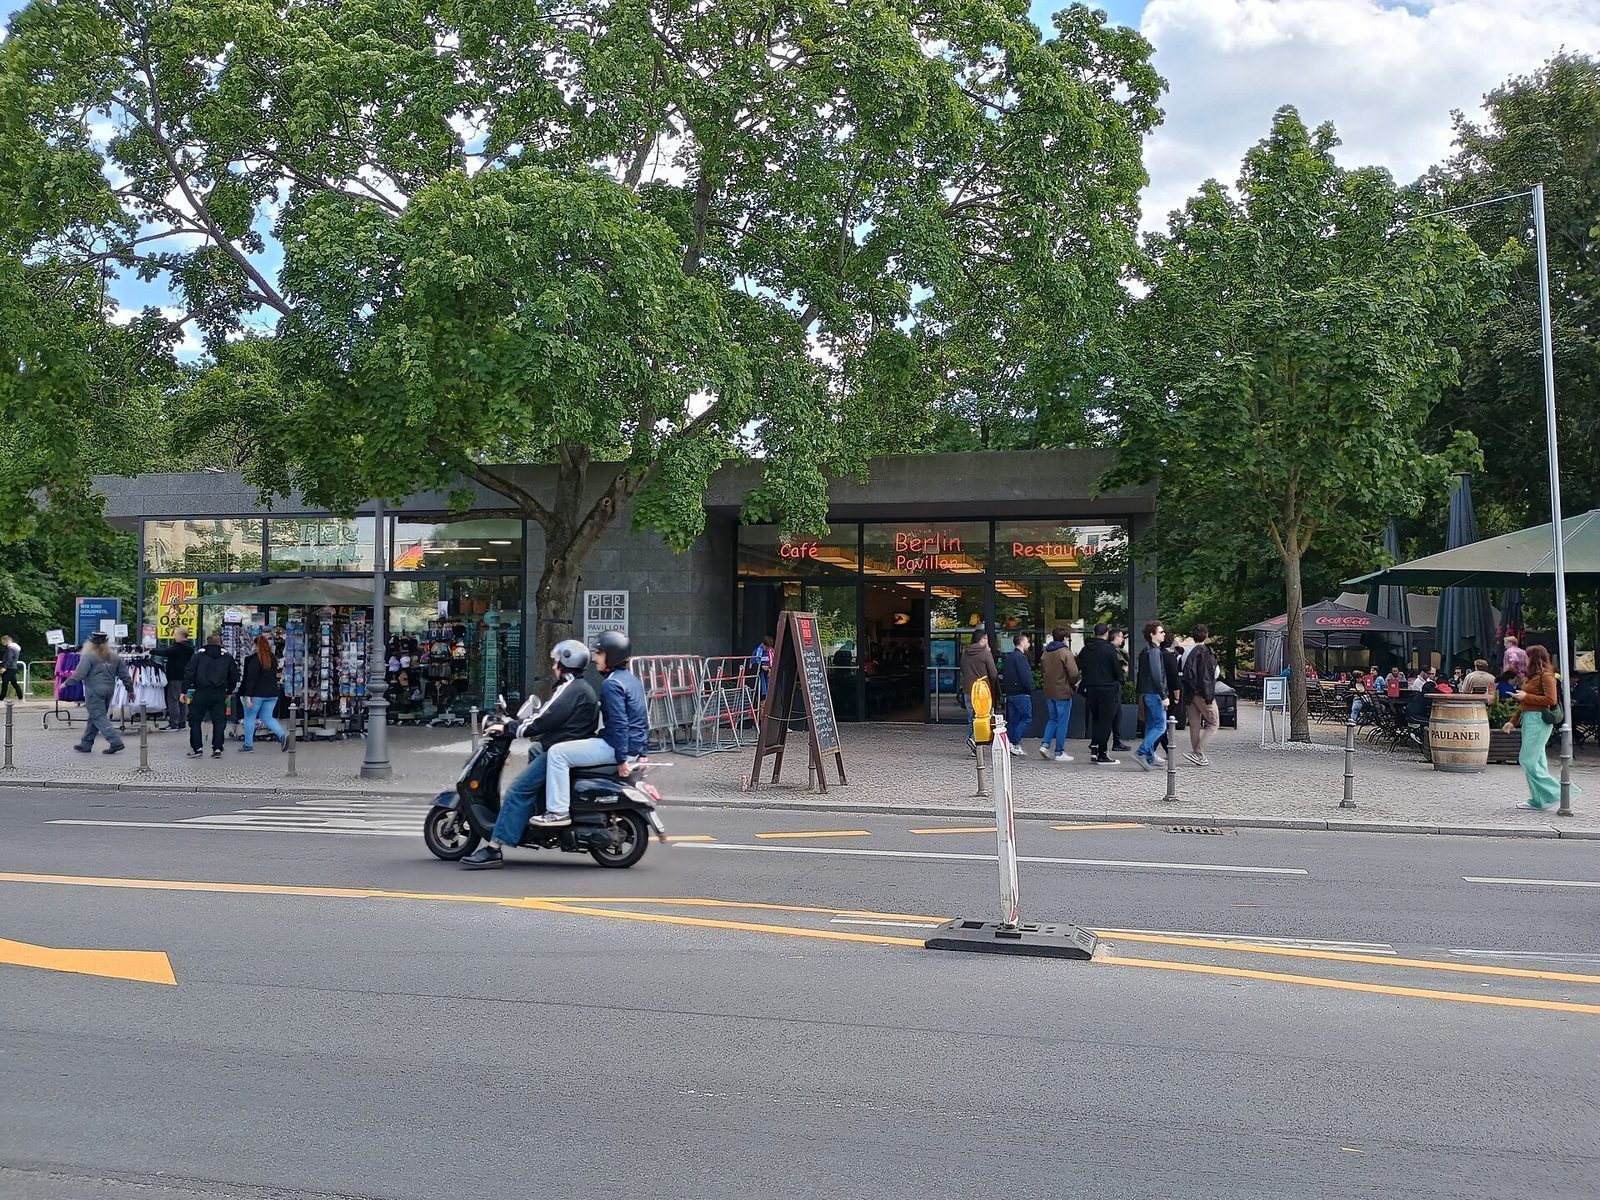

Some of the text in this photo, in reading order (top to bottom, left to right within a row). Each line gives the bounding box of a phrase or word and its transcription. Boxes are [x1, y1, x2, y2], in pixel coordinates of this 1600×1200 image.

[780, 542, 819, 558] Café
[894, 532, 961, 553] Berlin
[1012, 541, 1109, 557] Restauran
[896, 555, 958, 571] Pavillon
[159, 580, 185, 606] 70
[160, 615, 194, 626] Oster
[1431, 730, 1480, 740] PAULANER
